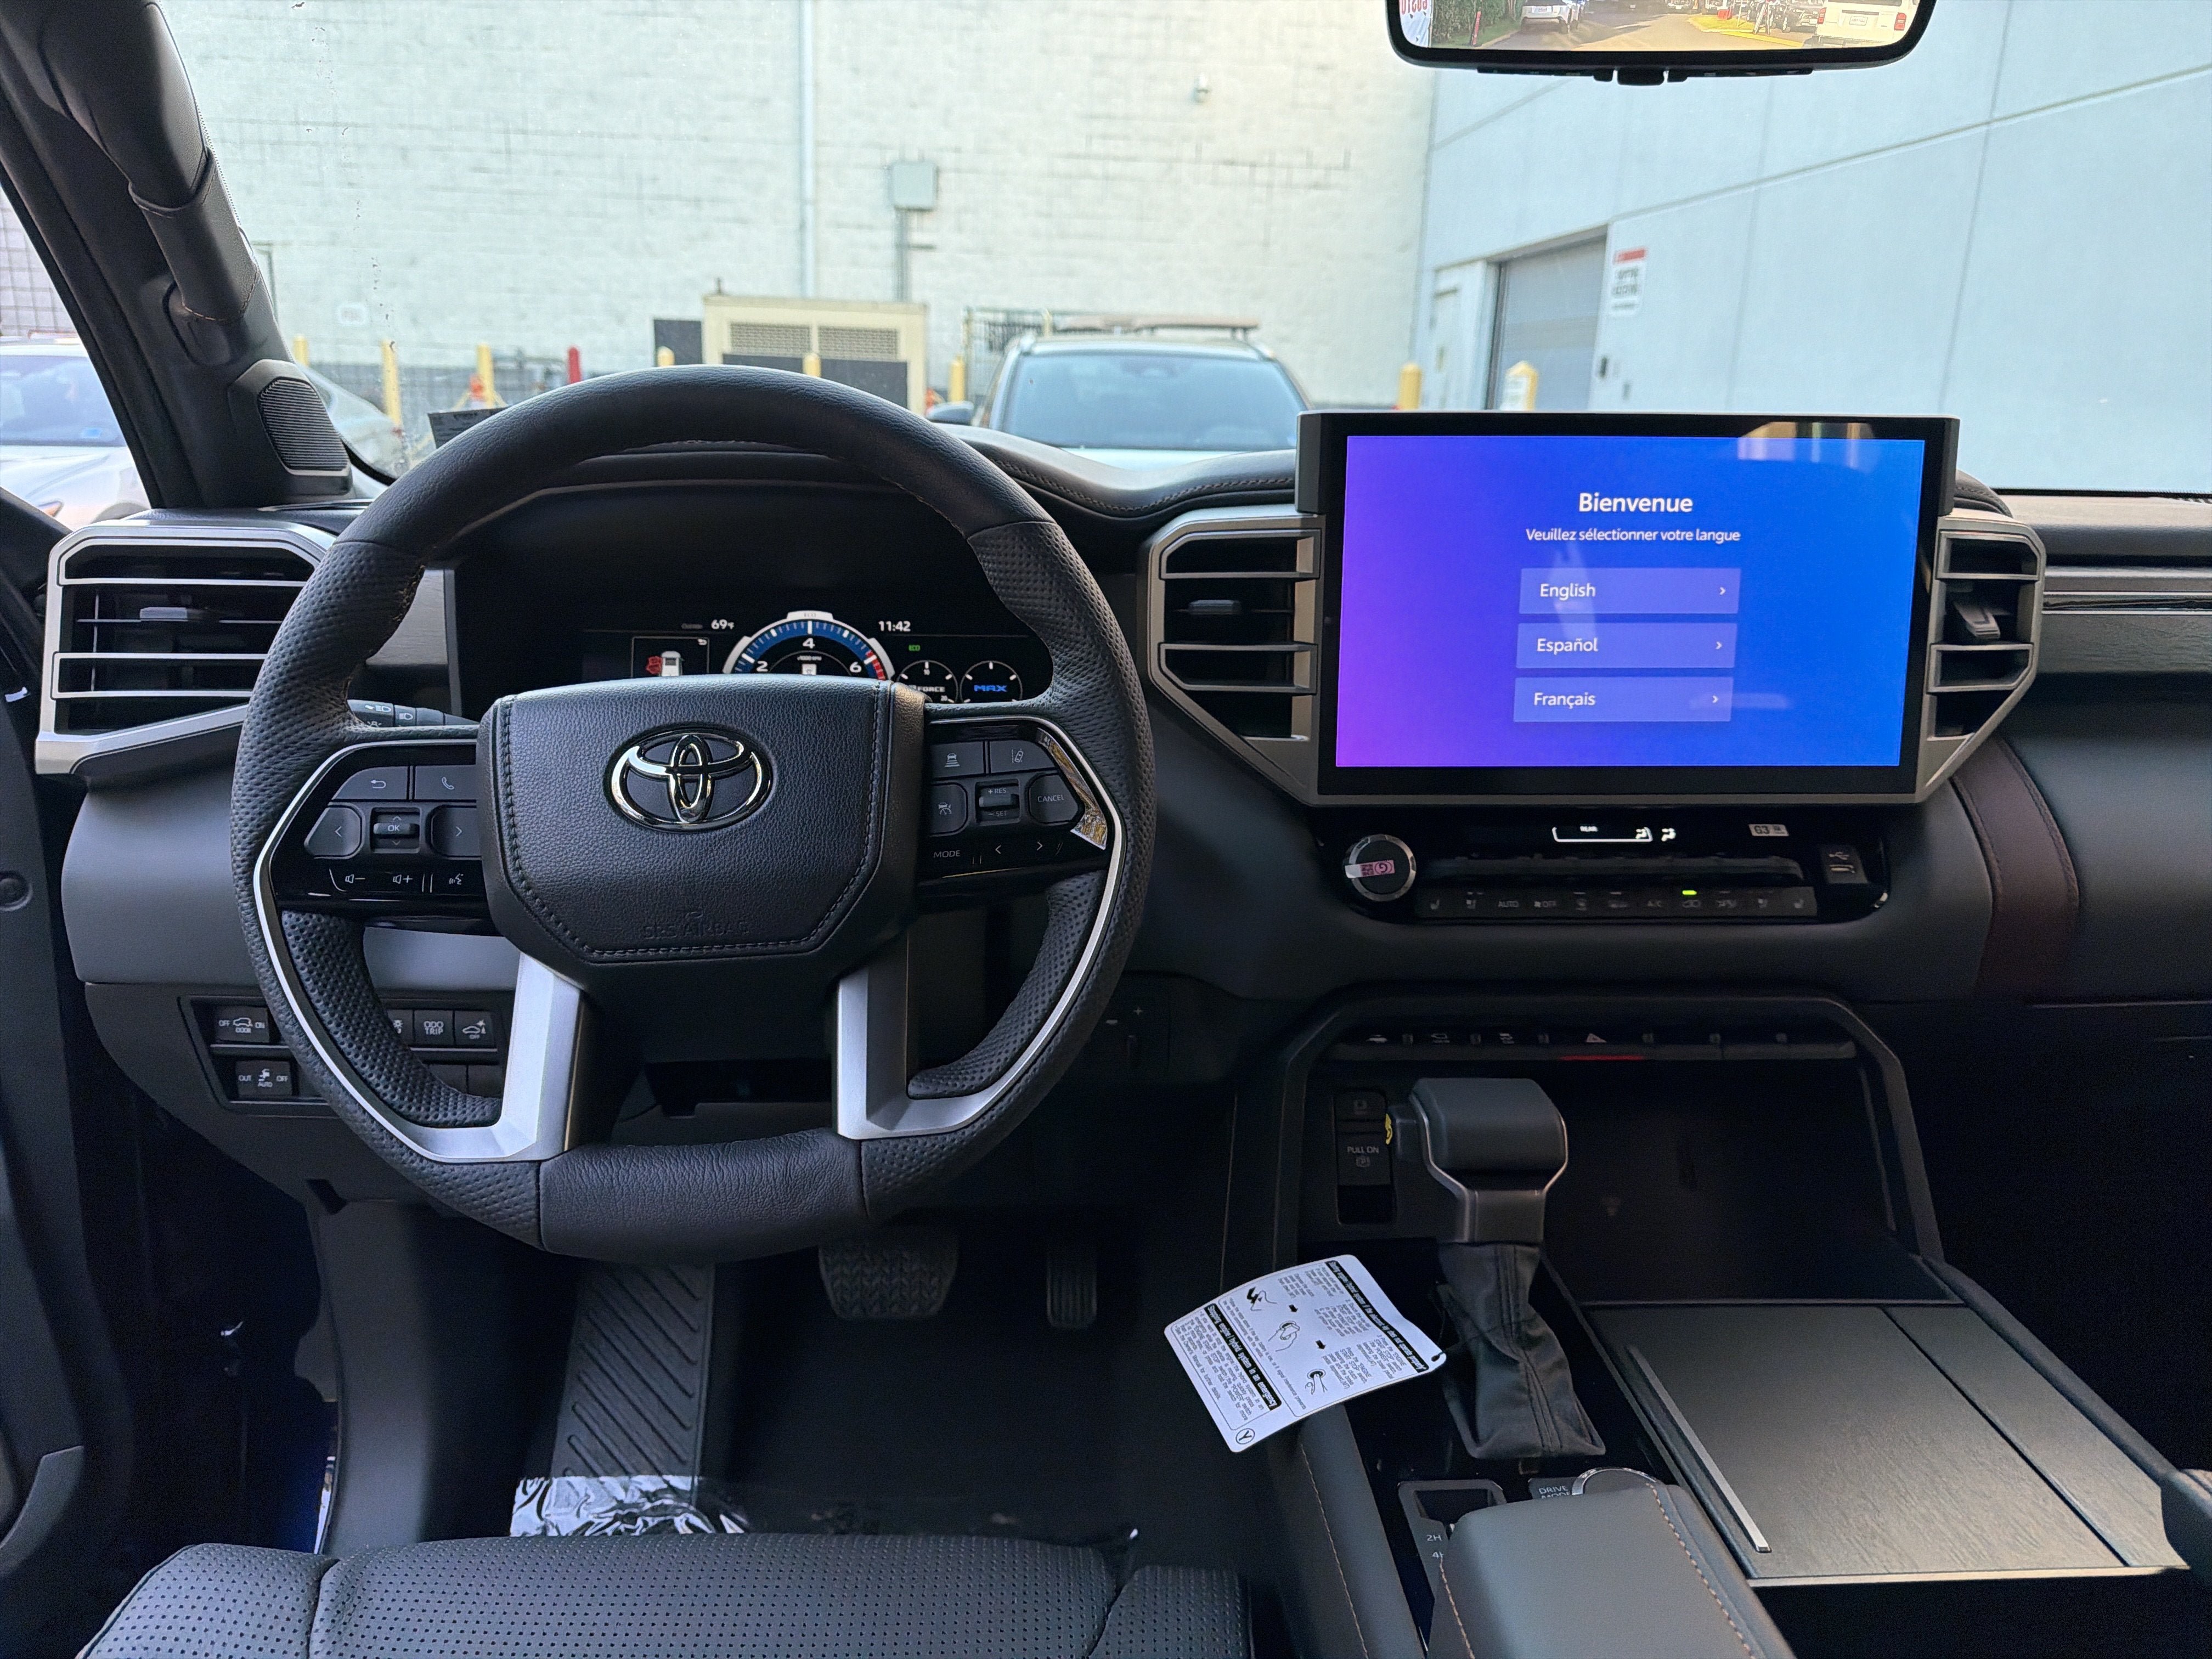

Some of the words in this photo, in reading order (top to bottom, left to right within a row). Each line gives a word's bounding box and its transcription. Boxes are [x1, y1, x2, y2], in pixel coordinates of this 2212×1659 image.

[1579, 492, 1693, 512] Bienvenue
[1526, 528, 1576, 541] Veuillez
[1578, 528, 1658, 541] sélectionner
[1660, 529, 1694, 541] votre
[1696, 529, 1741, 544] langue
[1540, 583, 1596, 601] English
[878, 620, 911, 631] 11:42
[803, 638, 815, 648] 4
[1537, 637, 1598, 655] Español
[757, 661, 768, 672] 2
[850, 661, 862, 673] 6
[1534, 692, 1595, 709] Français
[1037, 794, 1065, 803] CANCEL
[933, 849, 961, 859] MODE
[1238, 1352, 1251, 1368] system
[1258, 1382, 1277, 1407] emergency
[1238, 1430, 1252, 1441] Y
[1538, 1485, 1569, 1495] DRIVE
